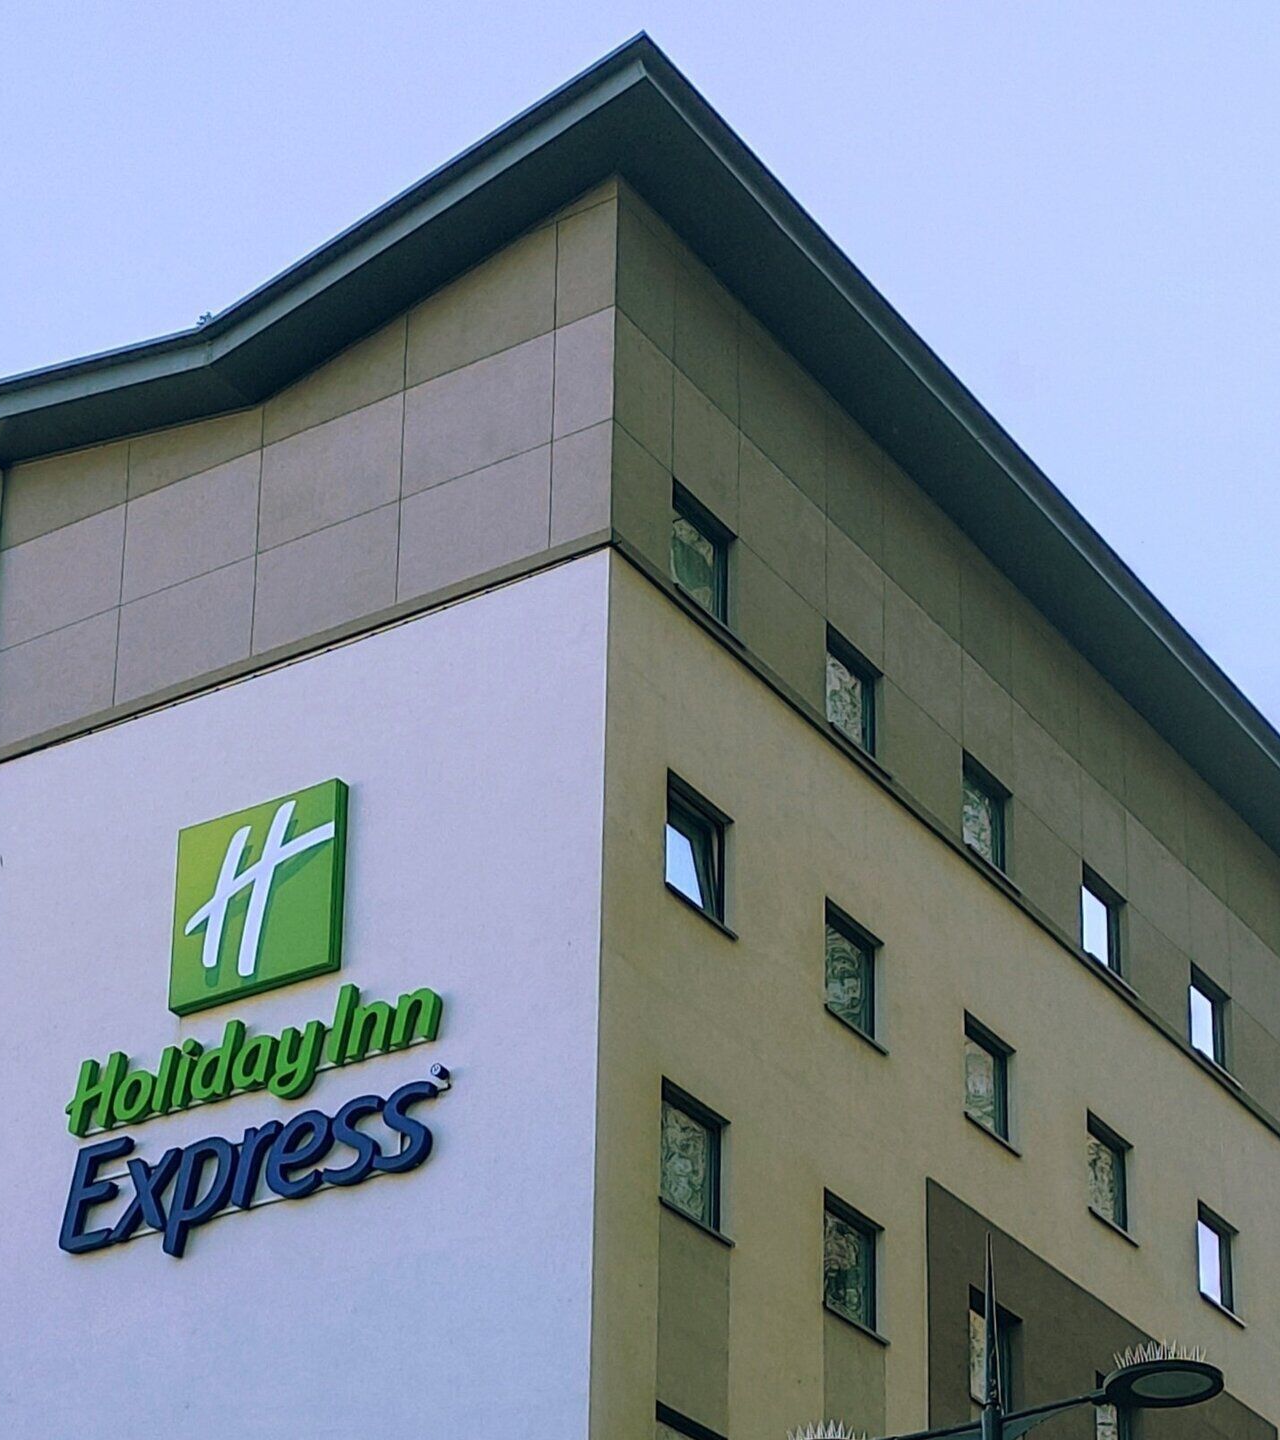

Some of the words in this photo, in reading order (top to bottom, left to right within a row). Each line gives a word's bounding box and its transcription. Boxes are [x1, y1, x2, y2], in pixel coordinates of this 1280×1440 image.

[184, 800, 335, 977] H
[66, 1018, 325, 1138] Holiday
[327, 983, 444, 1066] Inn
[59, 1081, 441, 1258] Express
